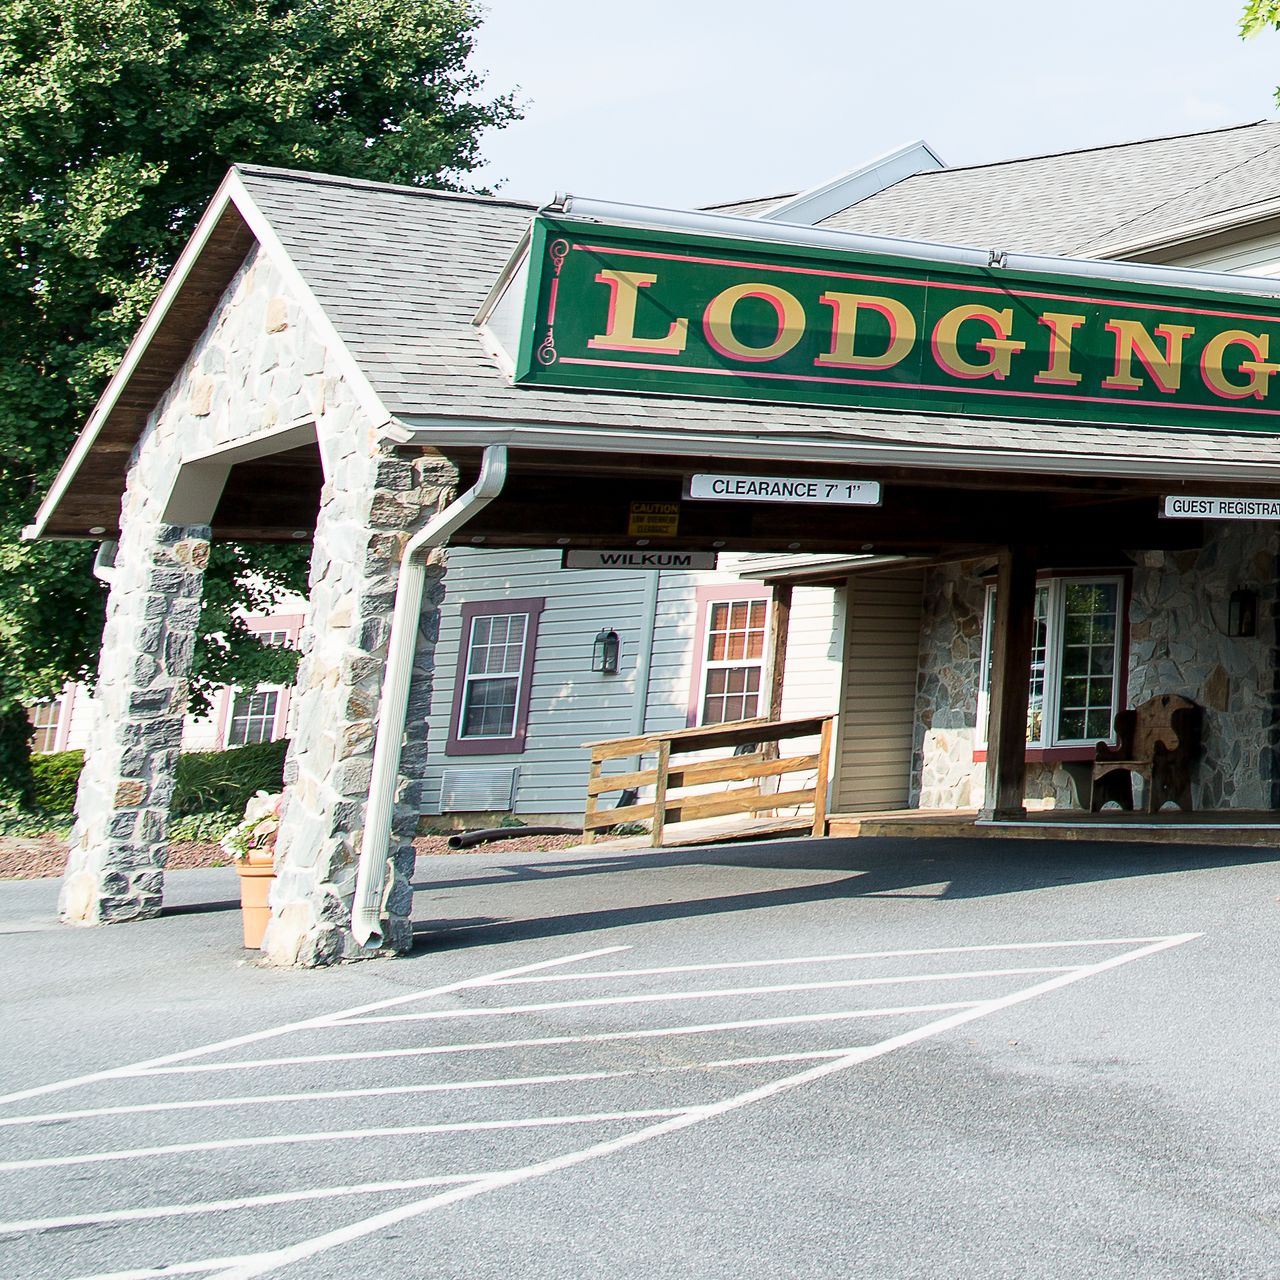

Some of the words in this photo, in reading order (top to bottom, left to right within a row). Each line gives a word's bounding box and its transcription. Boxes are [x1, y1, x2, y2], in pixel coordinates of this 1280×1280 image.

[588, 269, 1280, 400] LODGING
[712, 479, 818, 498] CLEARANCE
[632, 503, 679, 513] CAUTION
[1173, 500, 1215, 514] GUEST
[600, 553, 692, 566] WILKUM
